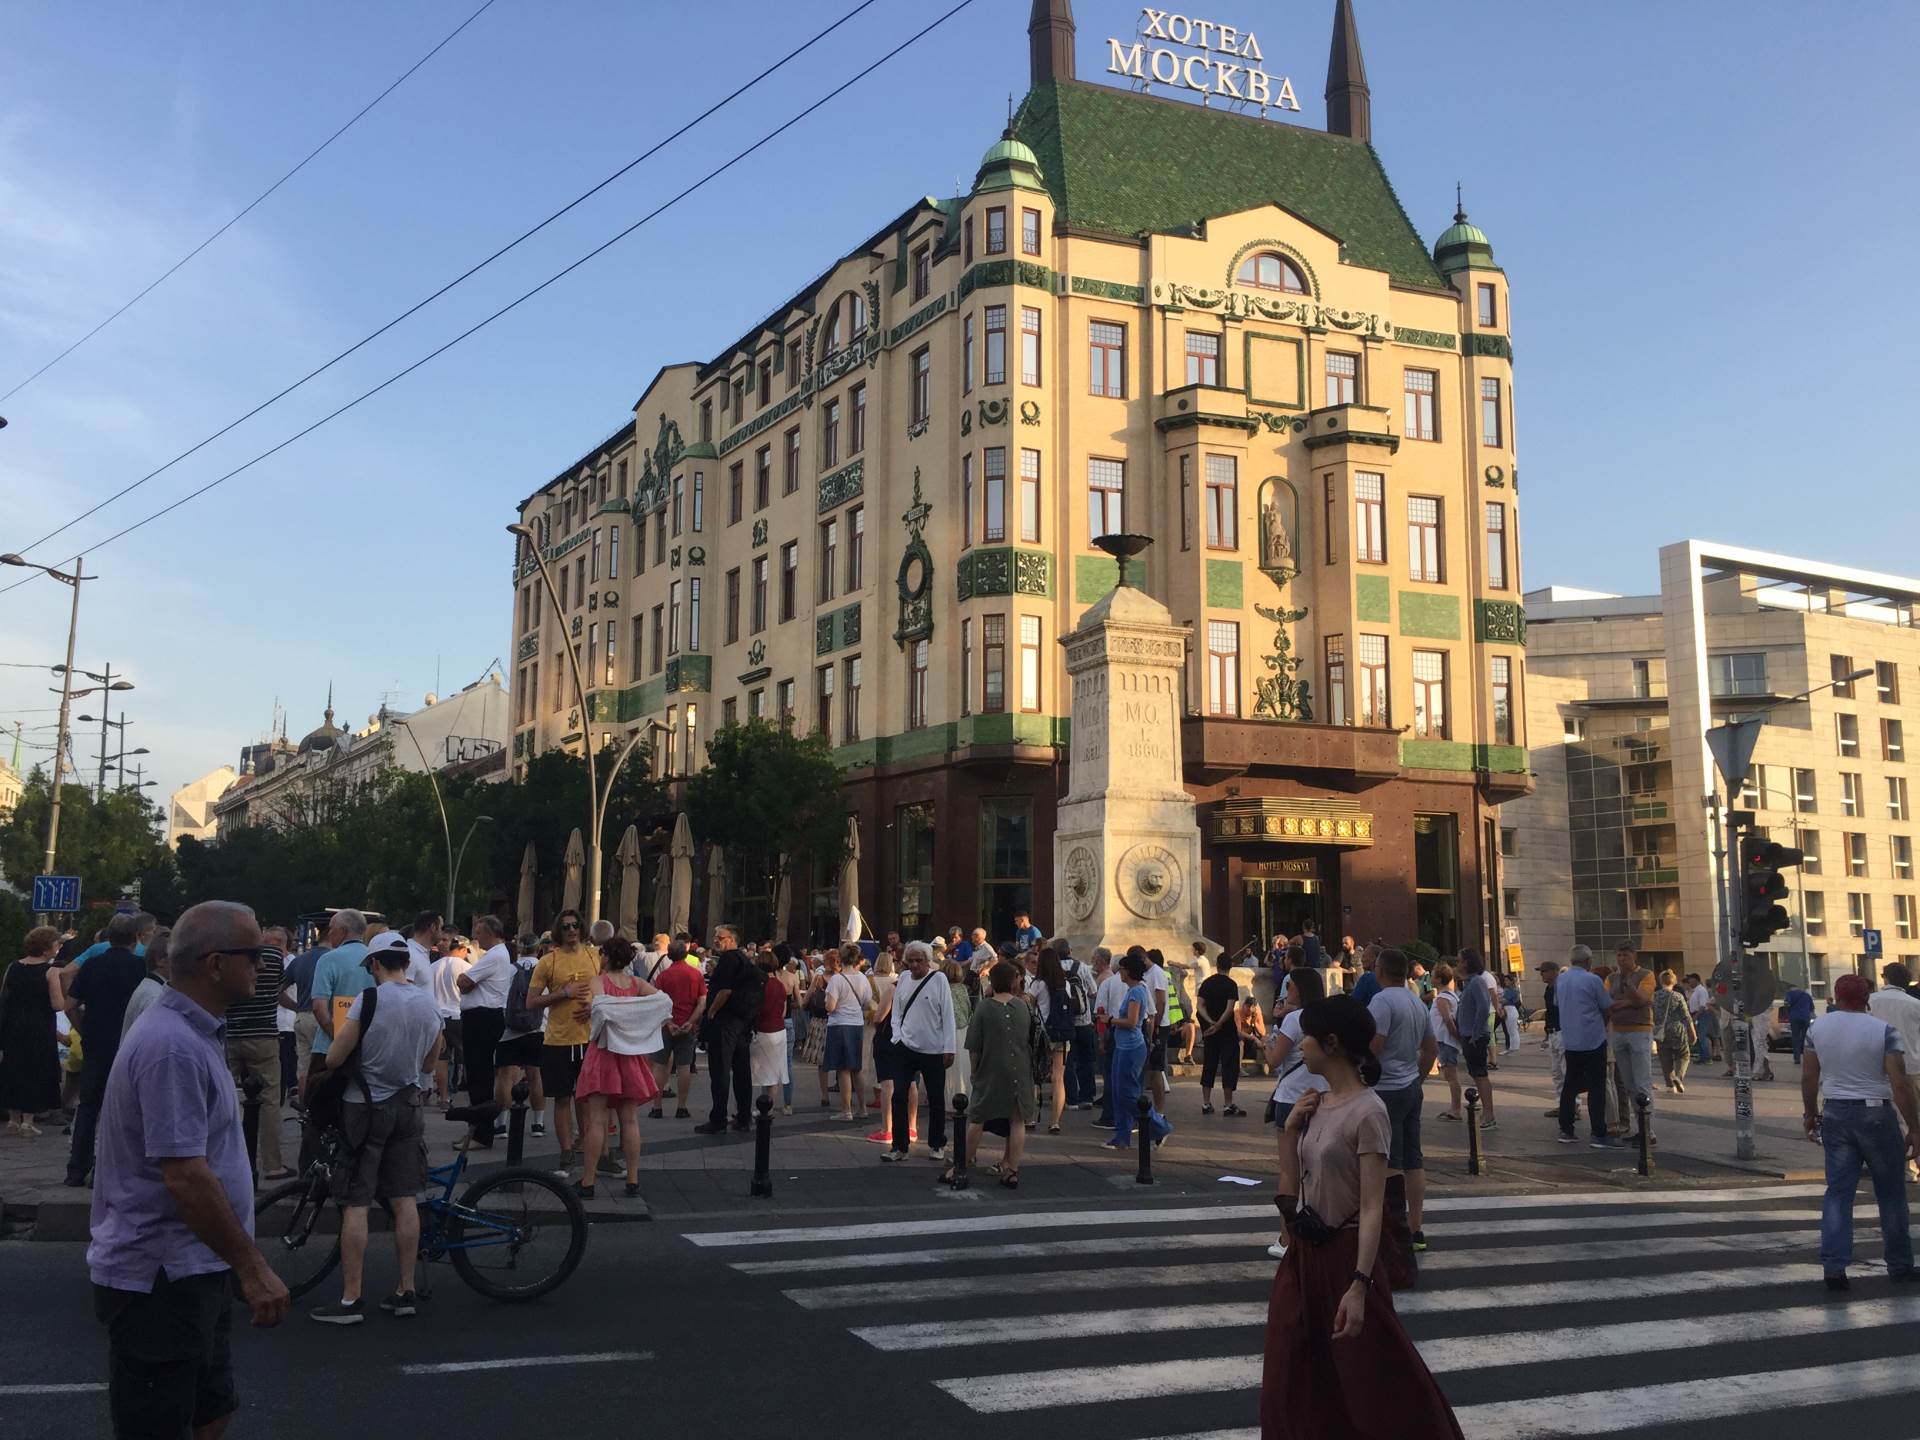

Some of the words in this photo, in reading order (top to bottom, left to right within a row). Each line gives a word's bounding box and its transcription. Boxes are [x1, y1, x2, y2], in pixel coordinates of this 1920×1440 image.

[1106, 38, 1301, 112] МОСКВА
[1258, 861, 1281, 871] HOTEL
[1282, 861, 1310, 872] MOSKVA
[1508, 929, 1516, 943] P
[1867, 931, 1878, 950] P
